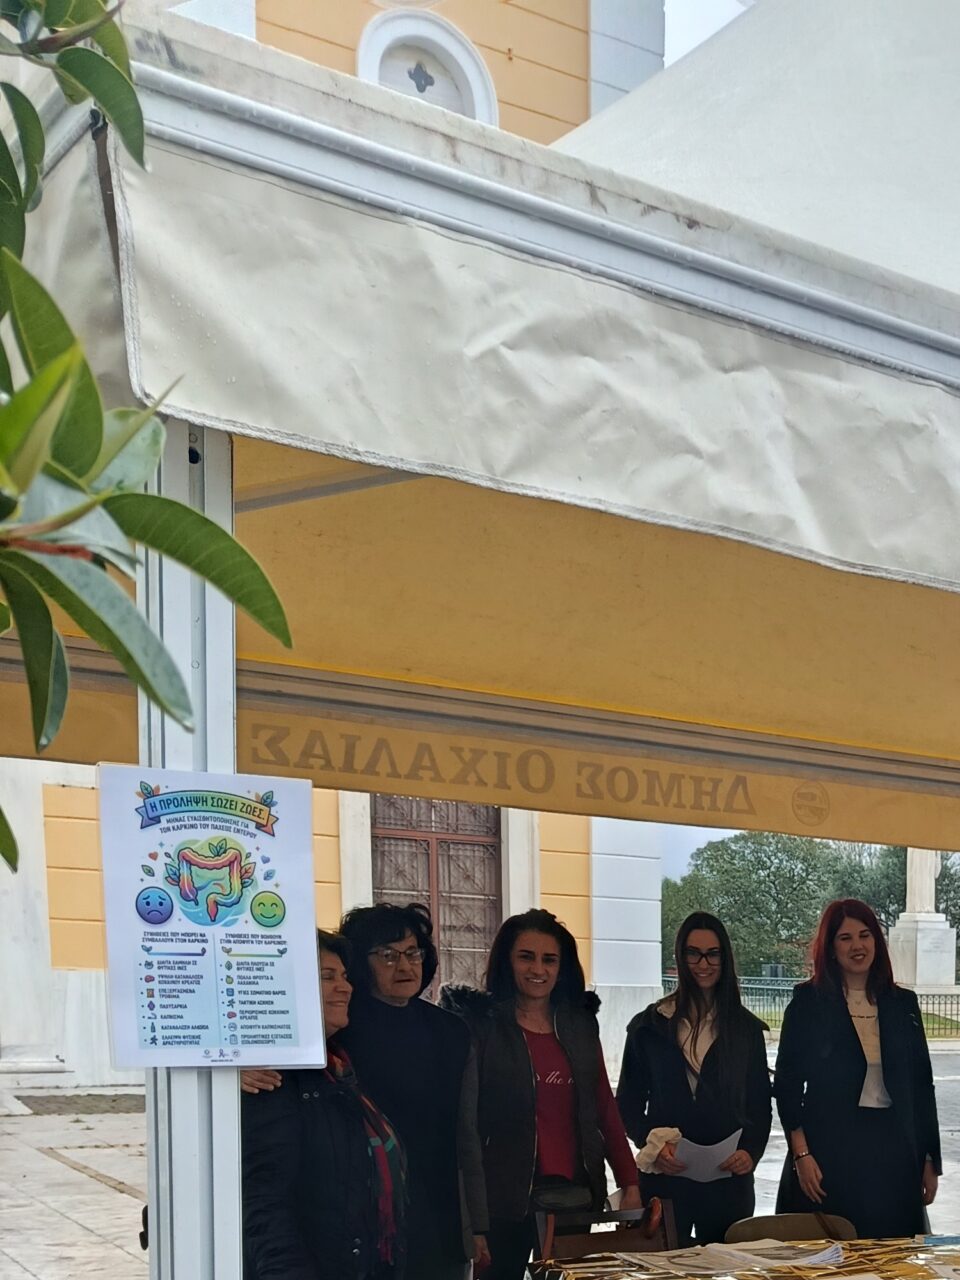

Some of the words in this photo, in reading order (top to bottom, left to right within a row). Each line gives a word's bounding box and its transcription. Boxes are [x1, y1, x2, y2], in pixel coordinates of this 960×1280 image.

[150, 802, 158, 812] Η
[159, 796, 208, 810] ΠΡΟΛΗΨΗ
[211, 797, 238, 811] ΣΩΖΕΙ
[240, 803, 265, 820] ΖΩΕΣ.
